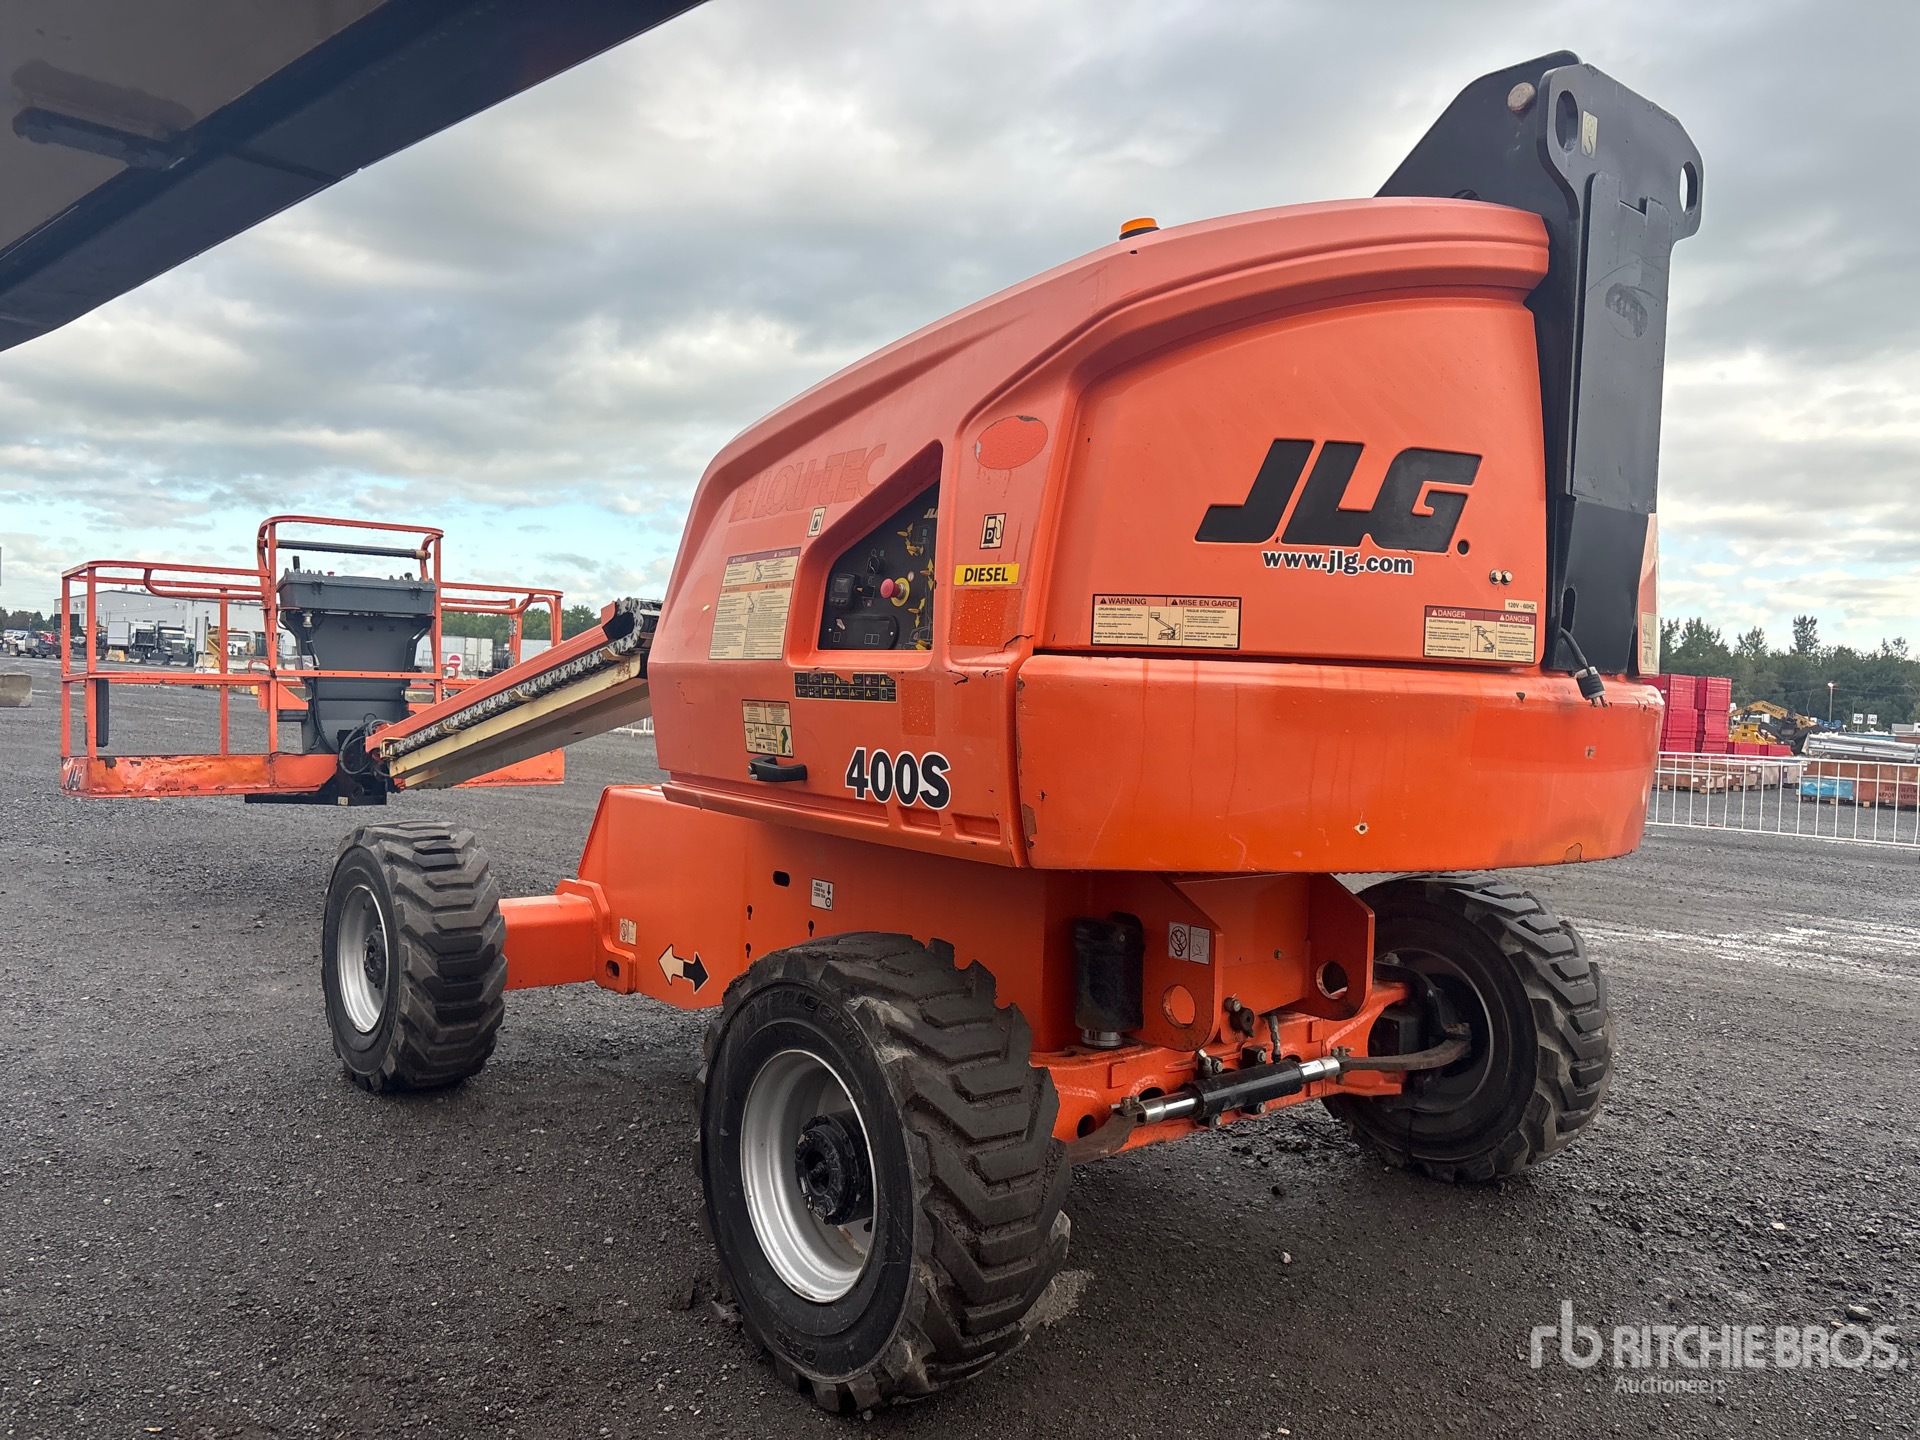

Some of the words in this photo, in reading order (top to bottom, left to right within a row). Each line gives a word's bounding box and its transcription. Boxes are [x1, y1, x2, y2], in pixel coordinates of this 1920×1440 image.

[1195, 438, 1483, 553] JLG
[923, 508, 939, 519] JL
[1262, 548, 1414, 576] www.jlg.com
[963, 567, 1008, 583] DIESEL
[1108, 598, 1147, 606] WARNING
[1179, 599, 1197, 607] MISE
[1212, 600, 1238, 608] GARDE
[1437, 609, 1466, 618] DANGER
[1504, 614, 1530, 623] DANGER
[845, 747, 951, 810] 400S
